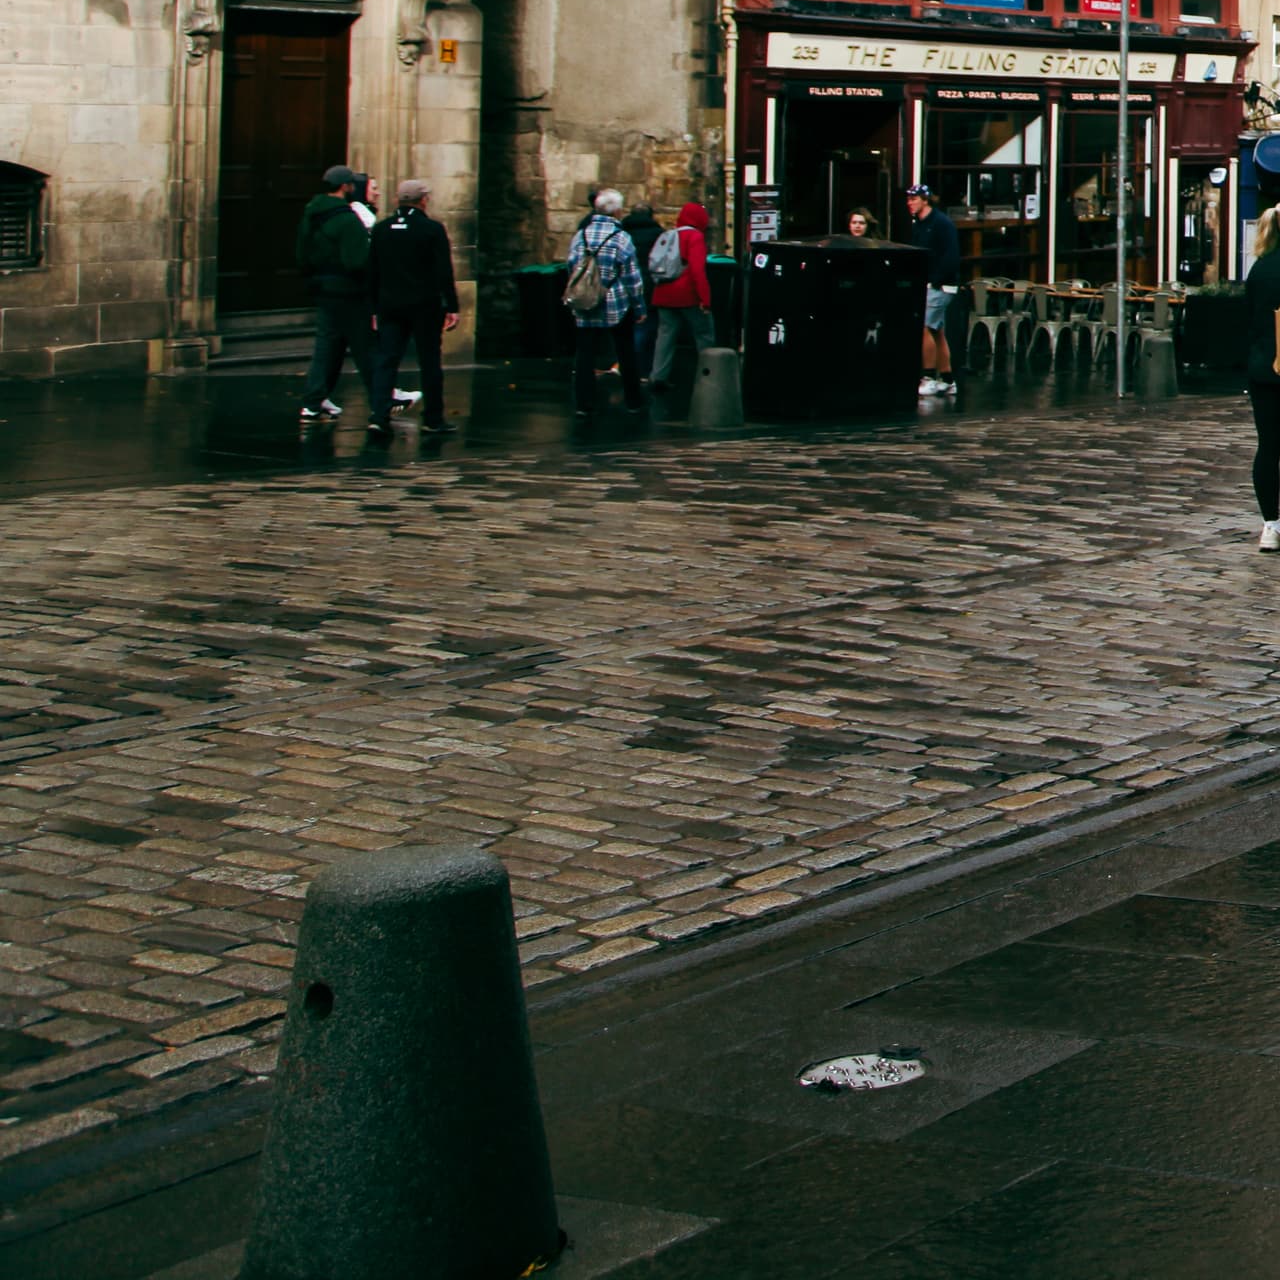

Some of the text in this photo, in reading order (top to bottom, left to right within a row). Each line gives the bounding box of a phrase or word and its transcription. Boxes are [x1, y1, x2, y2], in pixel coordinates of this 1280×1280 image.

[441, 40, 457, 63] H
[792, 46, 820, 61] 235
[847, 45, 895, 68] THE
[923, 50, 1016, 74] FILLING
[1040, 55, 1122, 77] STATION
[809, 86, 883, 97] FILLING STATION
[937, 90, 1039, 102] PIZZA PASTA BURGERS
